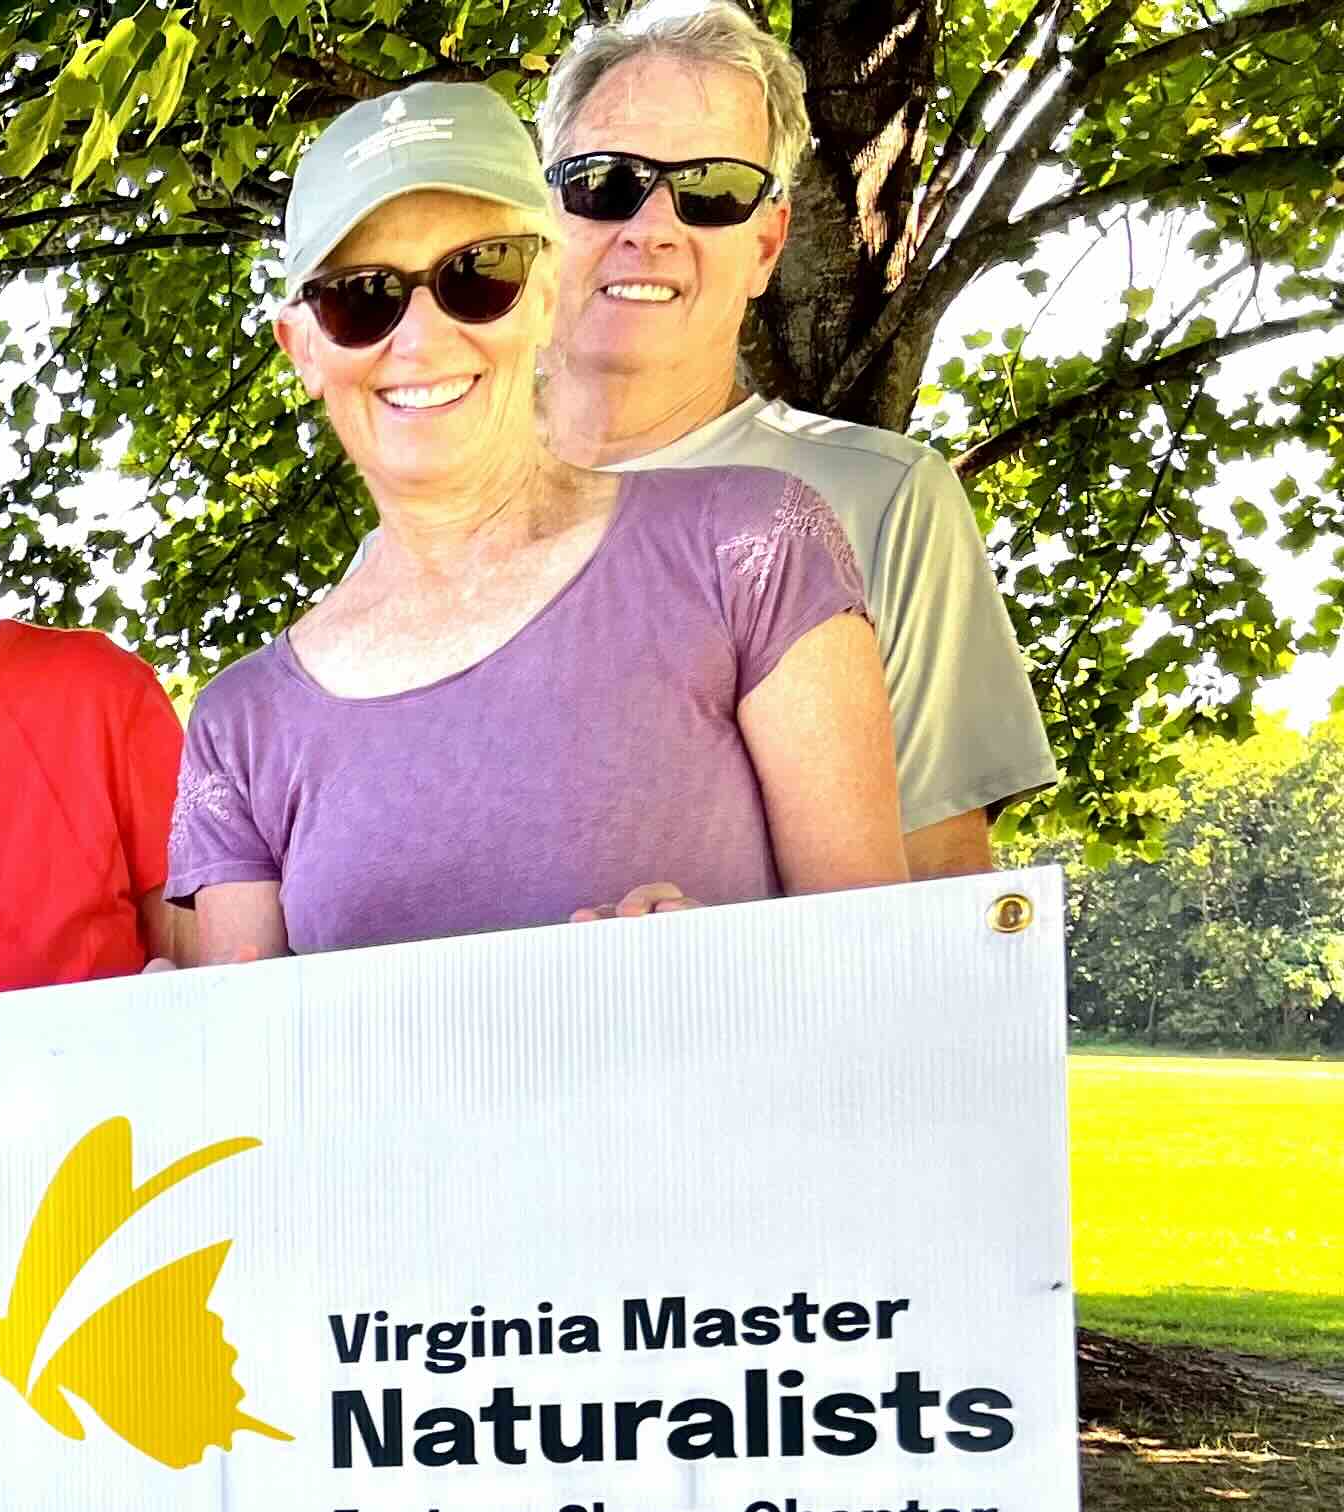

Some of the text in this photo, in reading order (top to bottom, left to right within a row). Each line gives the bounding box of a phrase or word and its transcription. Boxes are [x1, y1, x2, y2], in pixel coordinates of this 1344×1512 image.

[329, 1292, 910, 1373] Virginia Master
[332, 1369, 1014, 1469] Naturalists
